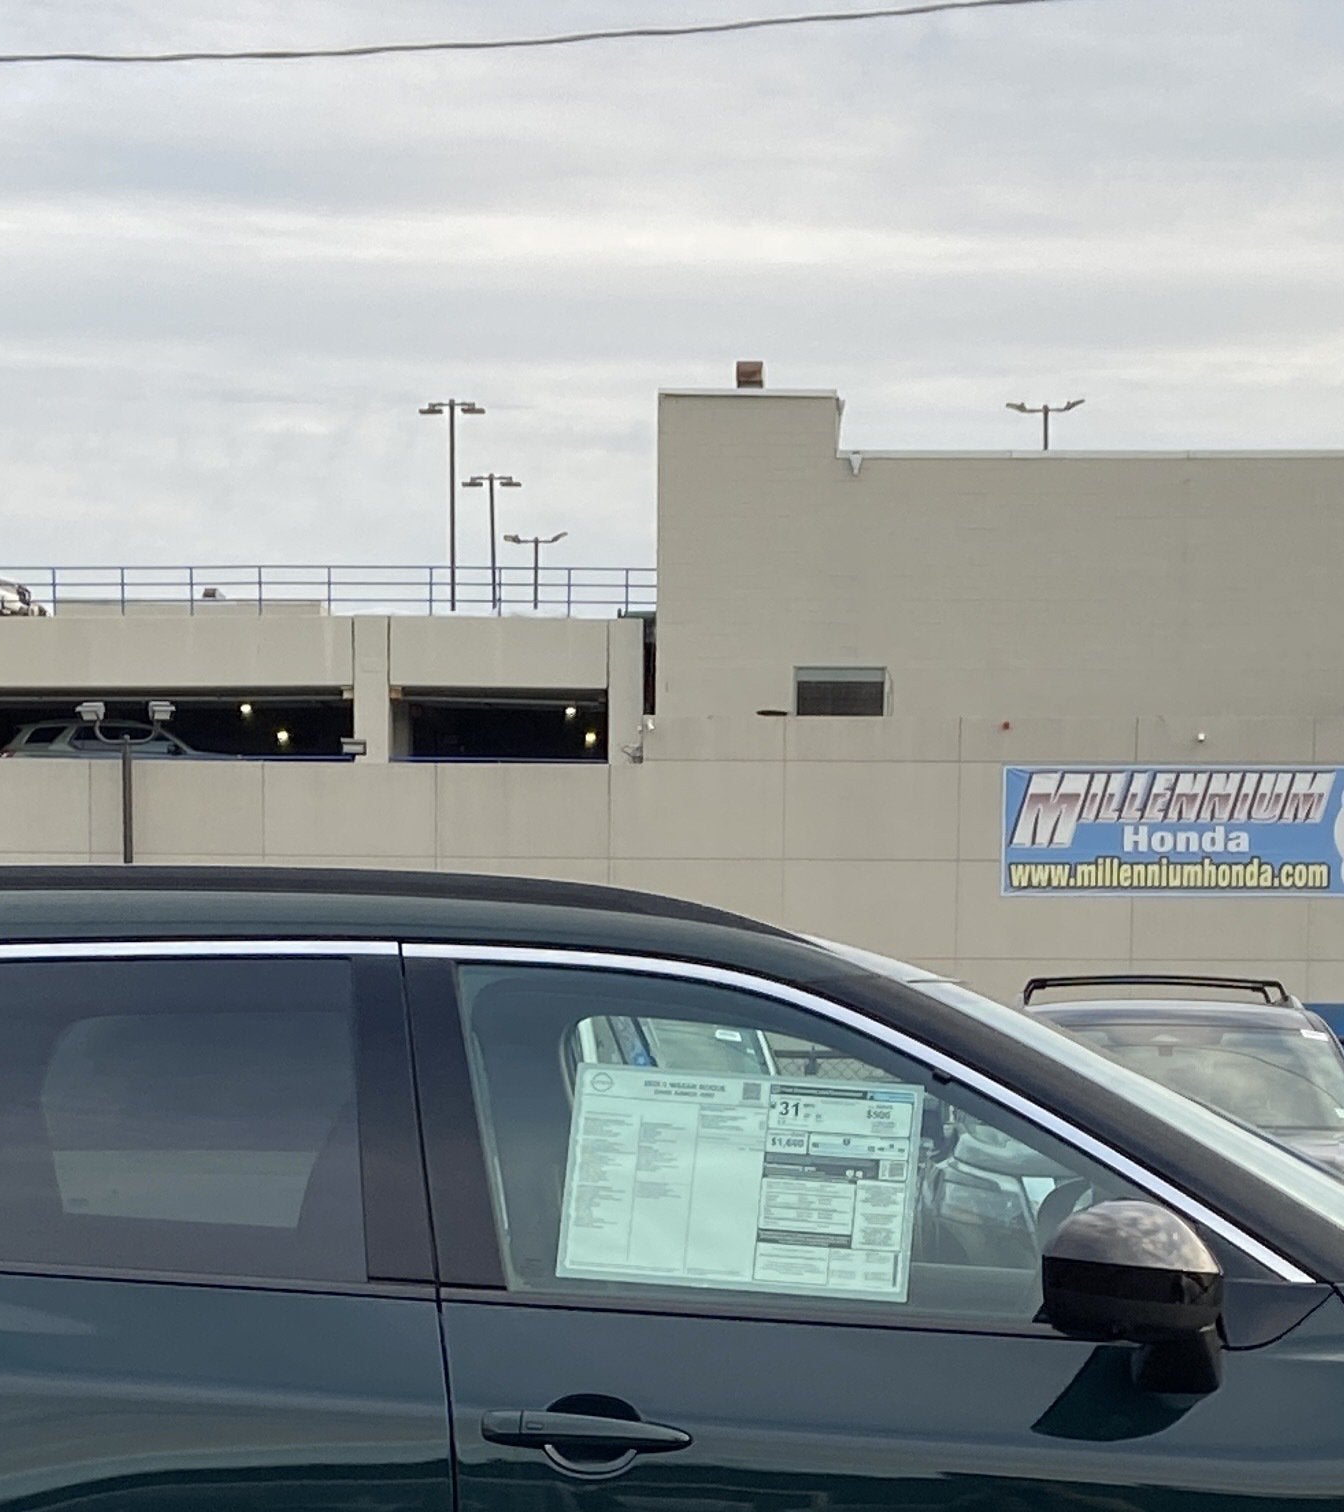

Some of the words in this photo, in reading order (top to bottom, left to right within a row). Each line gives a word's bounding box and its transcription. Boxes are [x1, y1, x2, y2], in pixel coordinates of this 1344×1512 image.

[1009, 771, 1336, 848] MILLENNIUM
[1123, 825, 1250, 853] Honda
[1010, 857, 1329, 889] www.millenniumhonda.com
[779, 1101, 800, 1116] 31
